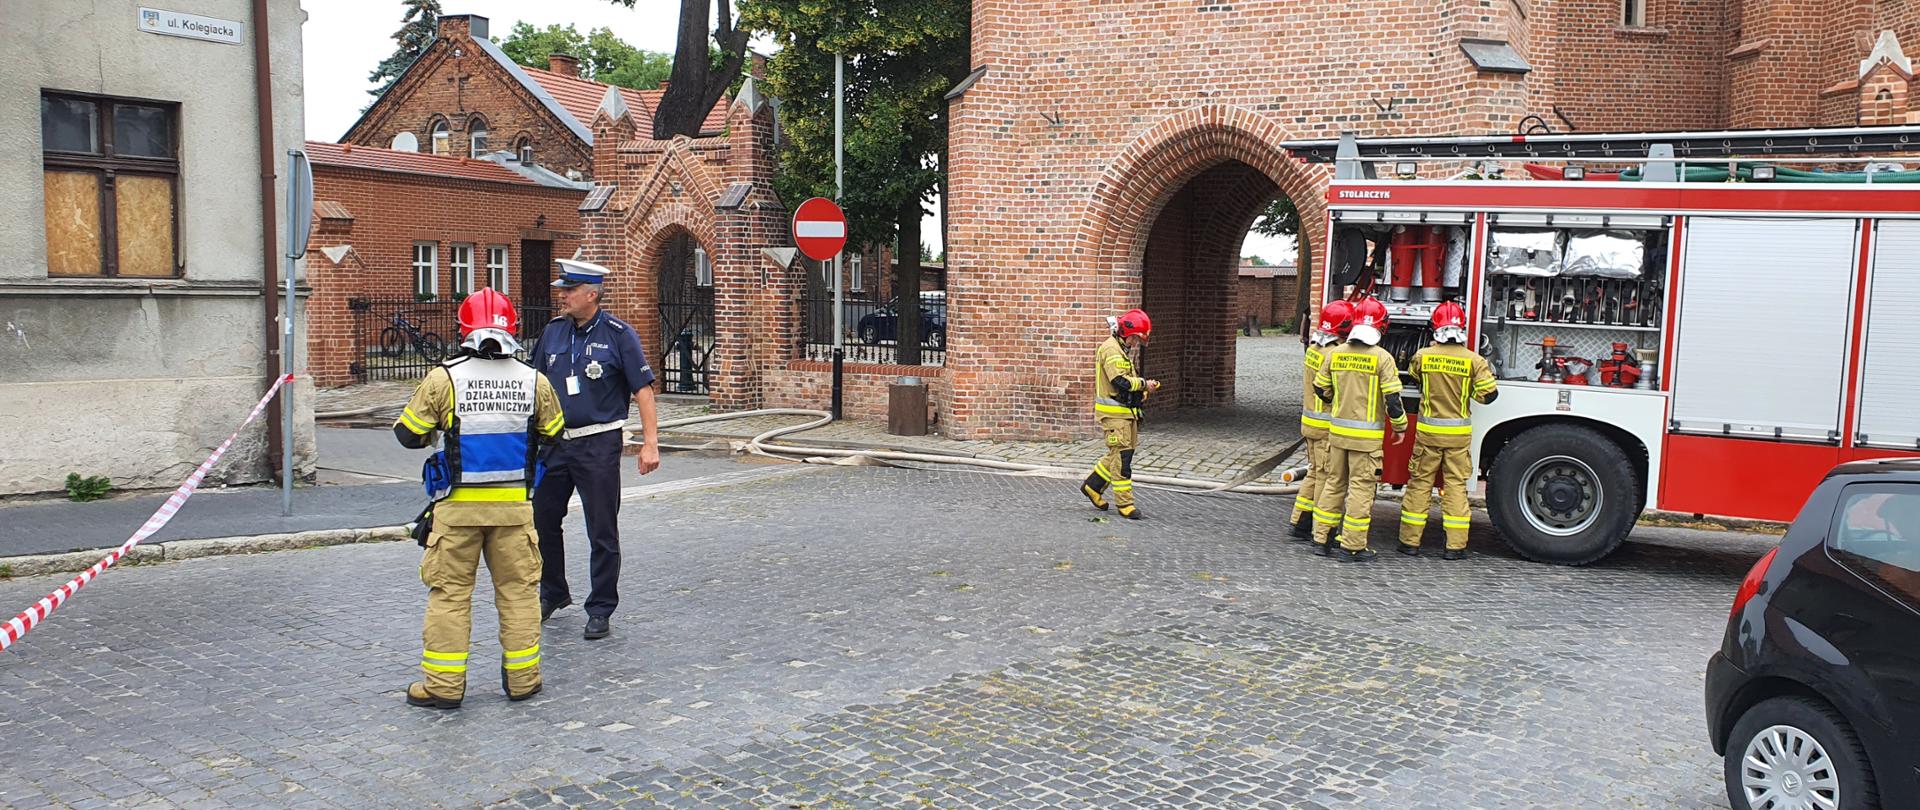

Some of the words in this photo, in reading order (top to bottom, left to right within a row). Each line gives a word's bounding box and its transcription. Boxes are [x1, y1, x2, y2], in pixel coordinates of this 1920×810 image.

[168, 18, 180, 28] ul.
[182, 20, 234, 36] Kolegiacka
[1339, 190, 1391, 199] STOLARCZYK
[493, 314, 508, 327] 16
[466, 391, 526, 401] DZIAŁANIEM
[459, 402, 531, 412] RATOWNICZYM
